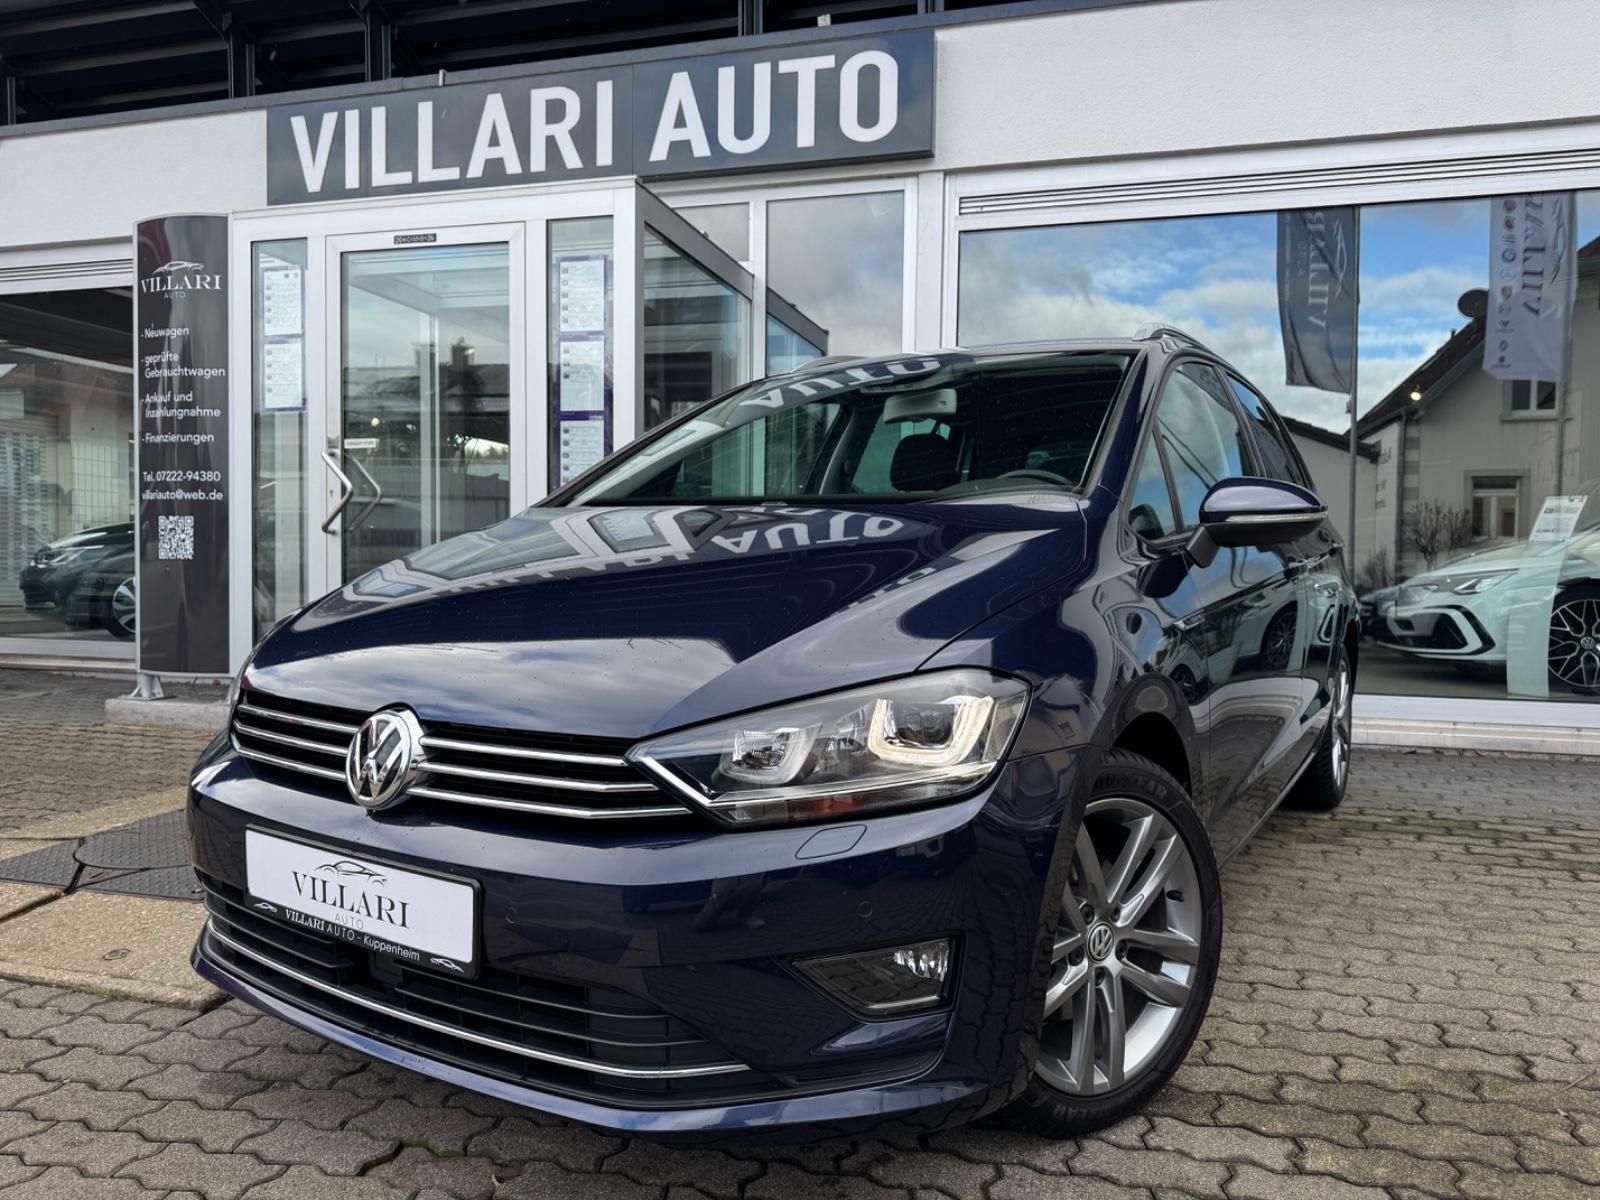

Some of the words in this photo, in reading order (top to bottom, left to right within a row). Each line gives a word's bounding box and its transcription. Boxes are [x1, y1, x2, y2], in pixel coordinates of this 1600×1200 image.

[290, 80, 613, 193] VILLARI
[649, 50, 899, 162] AUTO
[141, 274, 222, 294] VILLARI
[163, 291, 186, 299] AUTO
[145, 327, 189, 339] Neuwagen
[145, 351, 179, 366] geprüfte
[145, 365, 226, 379] Gebrauchtwagen
[145, 391, 172, 403] Ankauf
[173, 390, 193, 402] und
[145, 406, 221, 419] Inzahlungnahme
[145, 432, 215, 445] Finanzierungen
[156, 470, 221, 482] 07222-94380
[142, 488, 223, 501] villariauto@web.de
[292, 871, 410, 928] VILLARI
[334, 913, 364, 930] AUTO
[285, 908, 326, 931] VILLARI
[327, 923, 355, 941] AUTO
[363, 935, 420, 961] Kuppenheim
